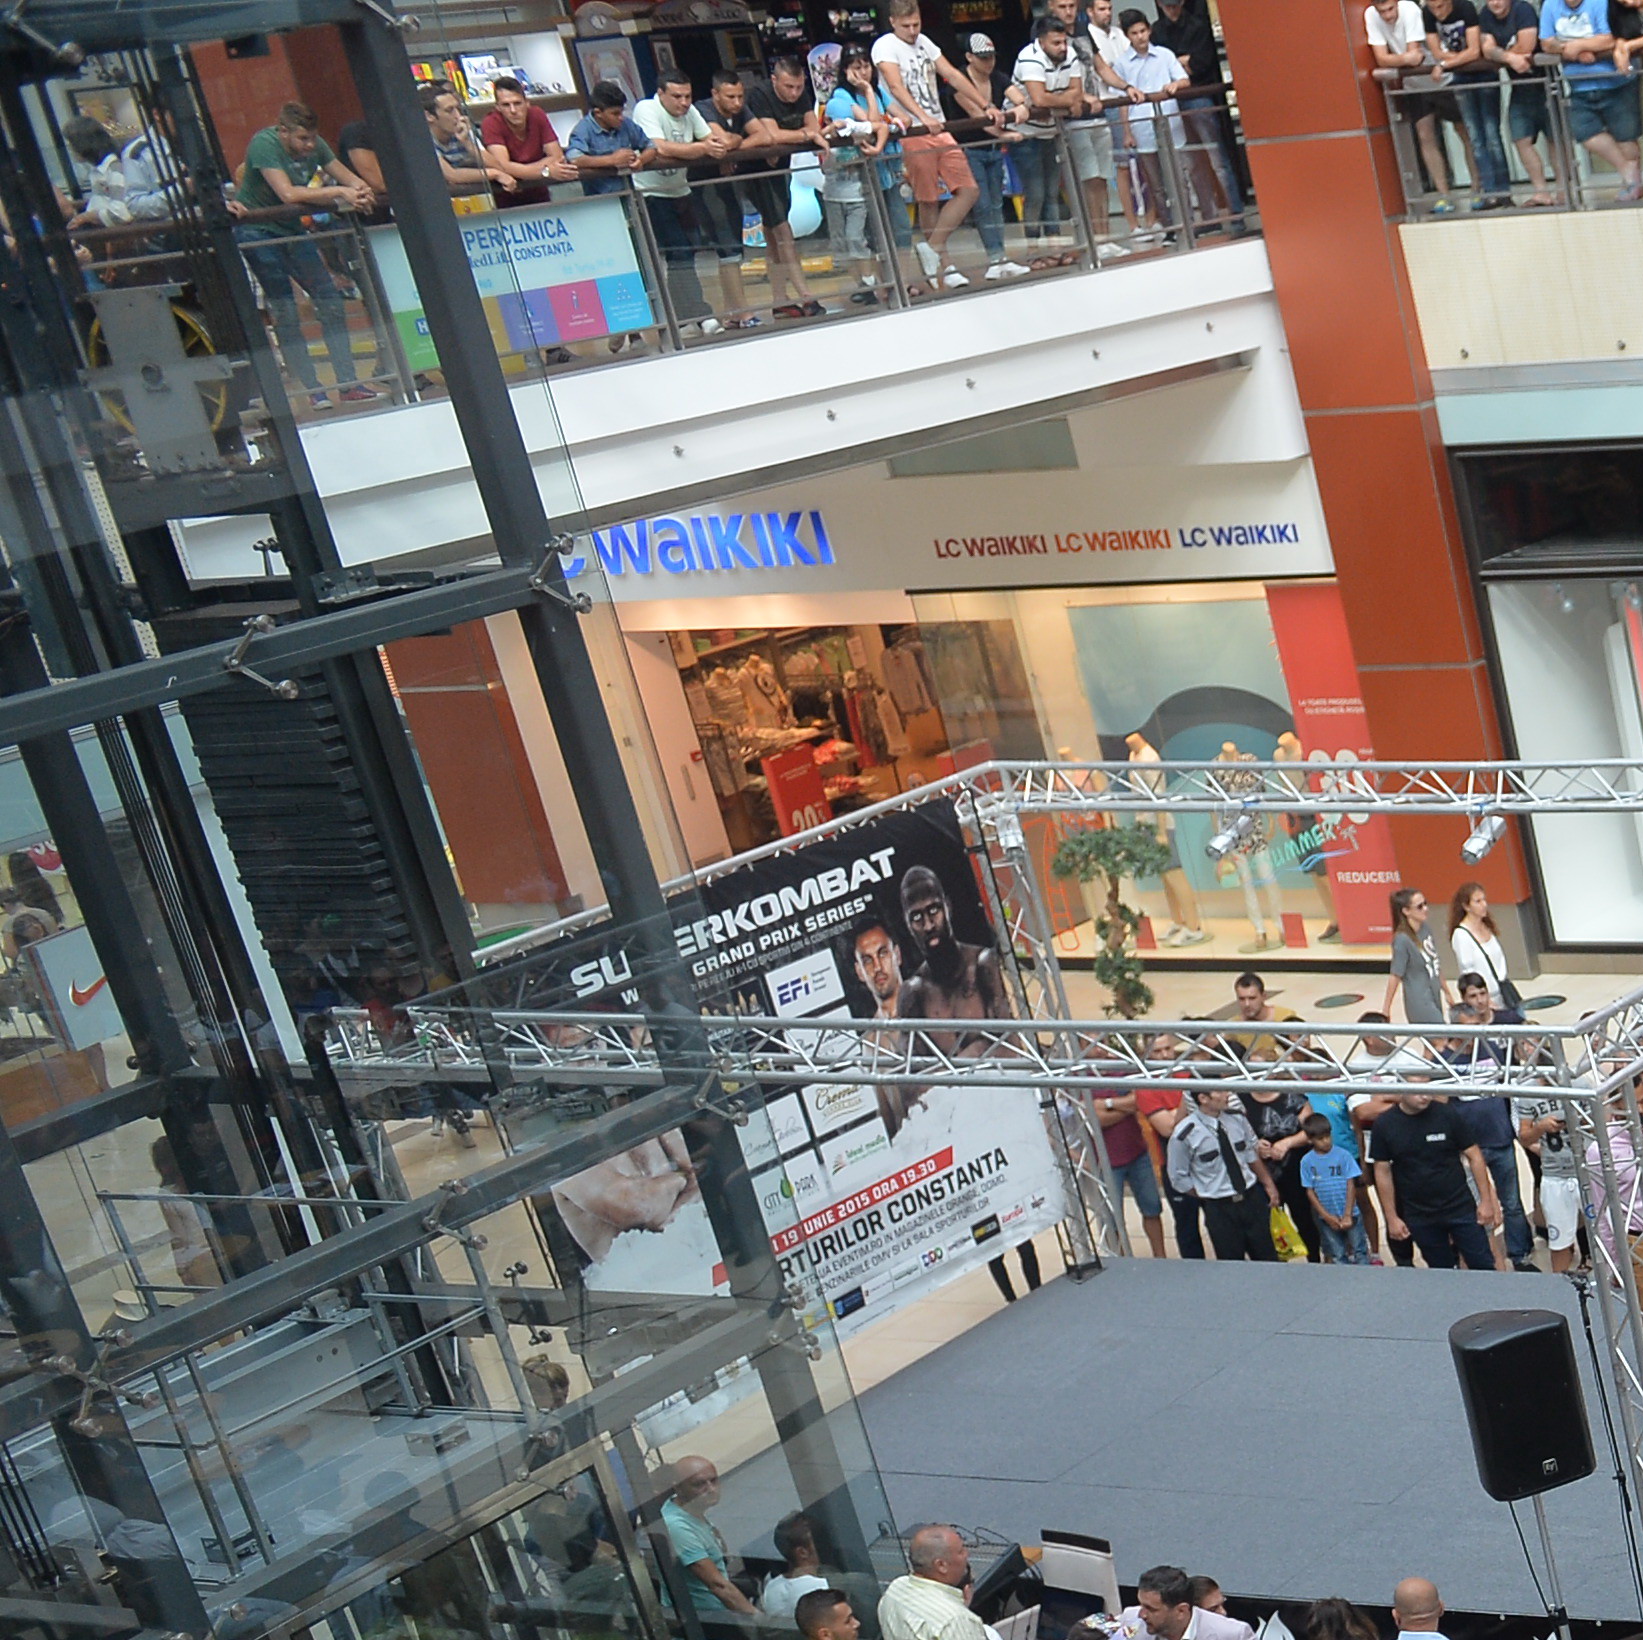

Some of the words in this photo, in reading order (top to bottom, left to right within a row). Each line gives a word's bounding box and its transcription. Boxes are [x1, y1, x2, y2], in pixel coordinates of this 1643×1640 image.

[463, 217, 569, 251] PERCLINICA
[934, 538, 961, 559] LC
[1054, 532, 1083, 553] LC
[1178, 526, 1207, 548] LC
[692, 940, 756, 977] GRAND
[759, 922, 802, 951] PRIX
[779, 1209, 885, 1282] RTURILOR
[887, 1146, 1009, 1225] CONSTANTA
[781, 1229, 799, 1247] 19
[803, 1209, 836, 1236] UNIE
[837, 1192, 871, 1219] 2015
[872, 1175, 900, 1200] ORA
[901, 1159, 937, 1186] 19.30
